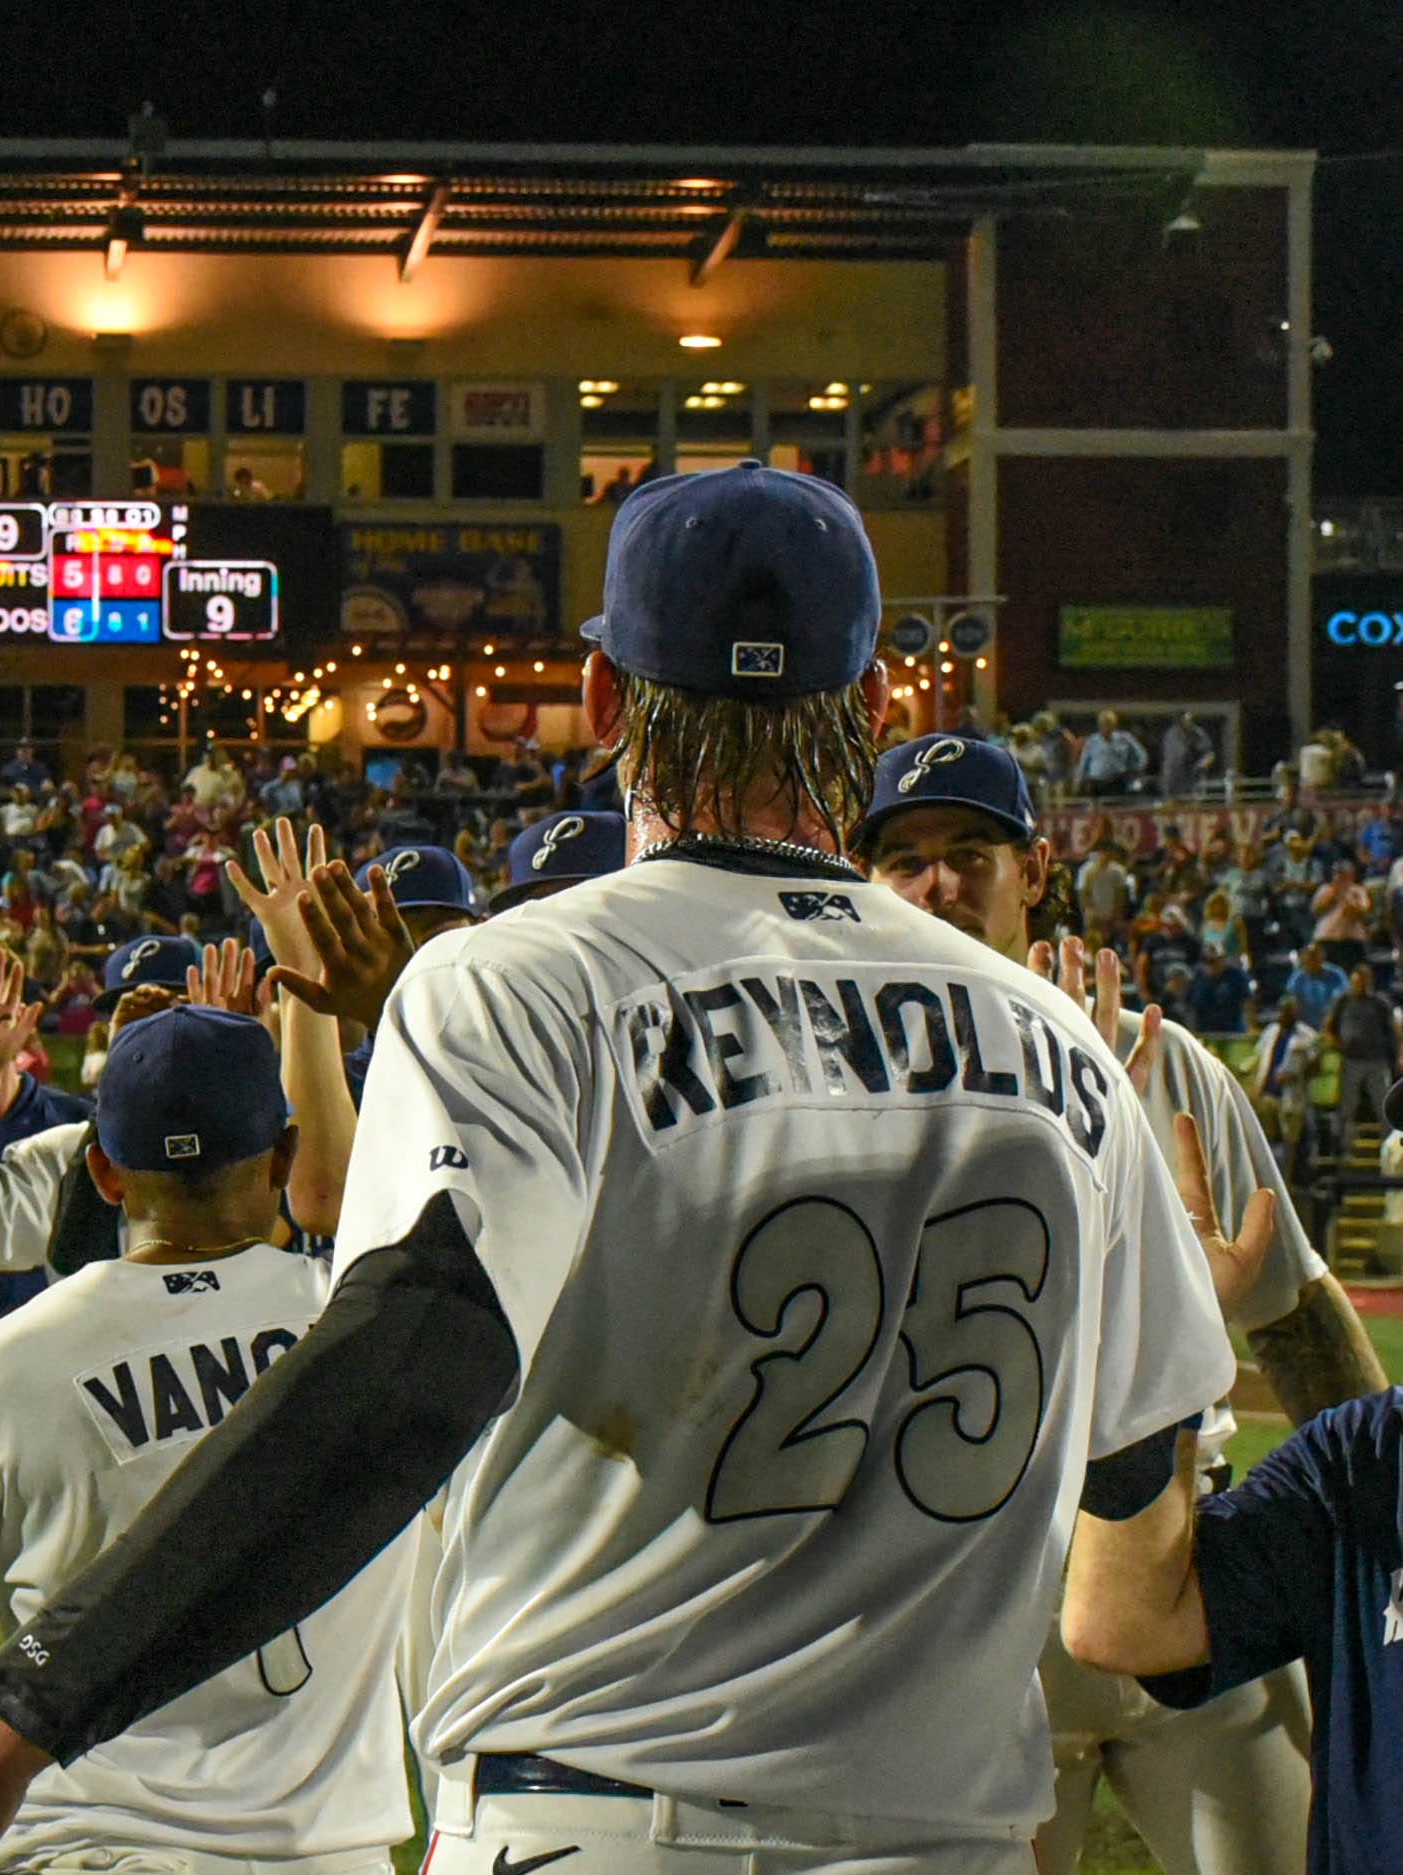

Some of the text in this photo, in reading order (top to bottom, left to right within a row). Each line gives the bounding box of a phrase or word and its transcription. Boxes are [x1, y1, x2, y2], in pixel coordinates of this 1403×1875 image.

[62, 559, 84, 588] 5
[178, 567, 262, 598] Inning
[206, 595, 235, 633] 9
[617, 975, 1109, 1158] REYNOLDS
[704, 1194, 1051, 1525] 25
